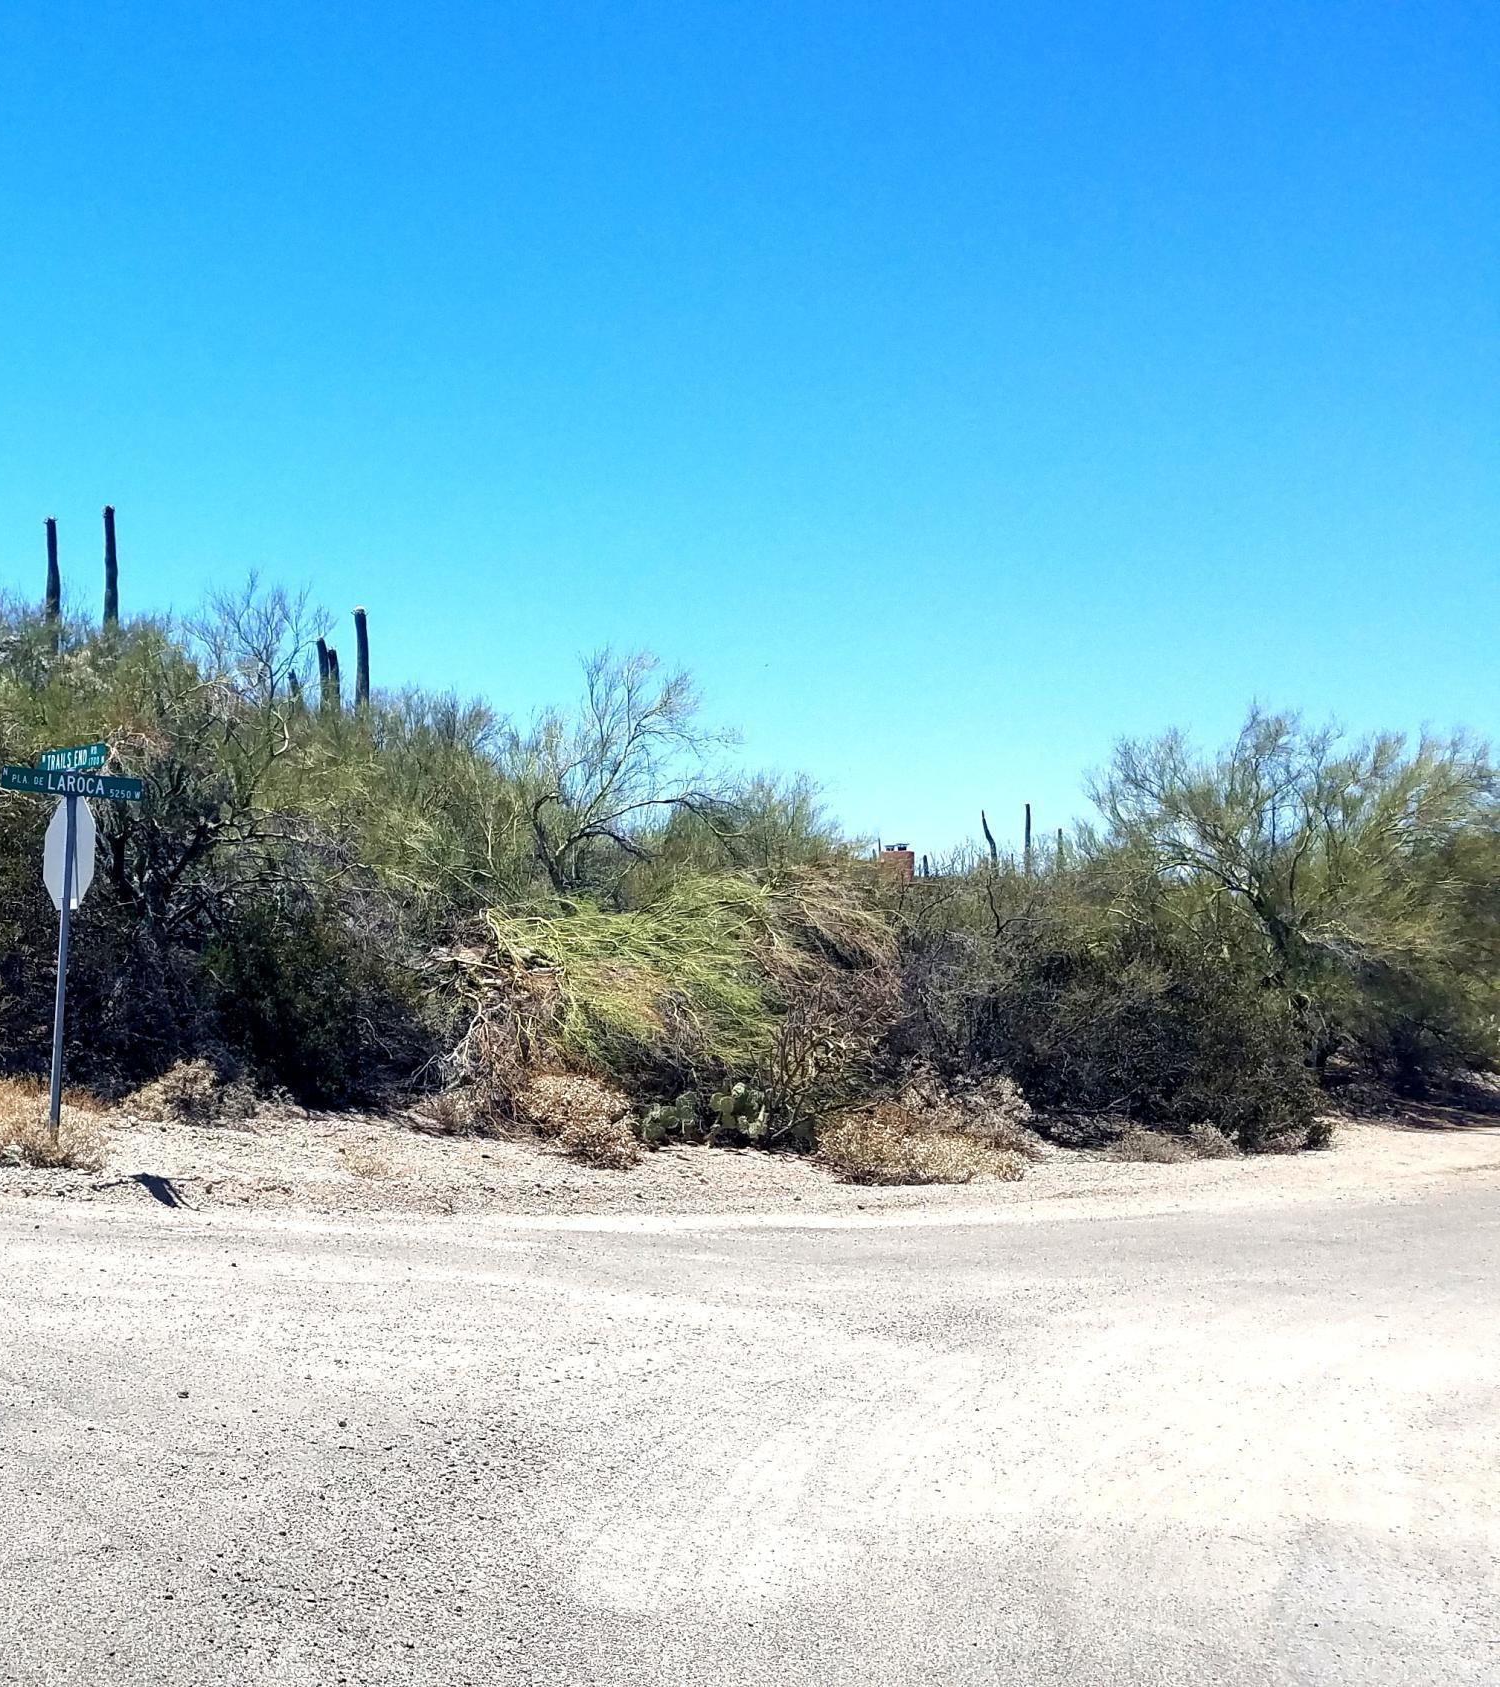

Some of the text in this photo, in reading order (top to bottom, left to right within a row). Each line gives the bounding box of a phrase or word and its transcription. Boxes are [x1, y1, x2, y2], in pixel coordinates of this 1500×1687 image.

[47, 752, 71, 771] TRAILS
[74, 749, 87, 767] END
[34, 776, 44, 786] DE
[48, 774, 104, 795] LAROCA
[110, 789, 132, 799] 5250
[135, 791, 141, 799] W
